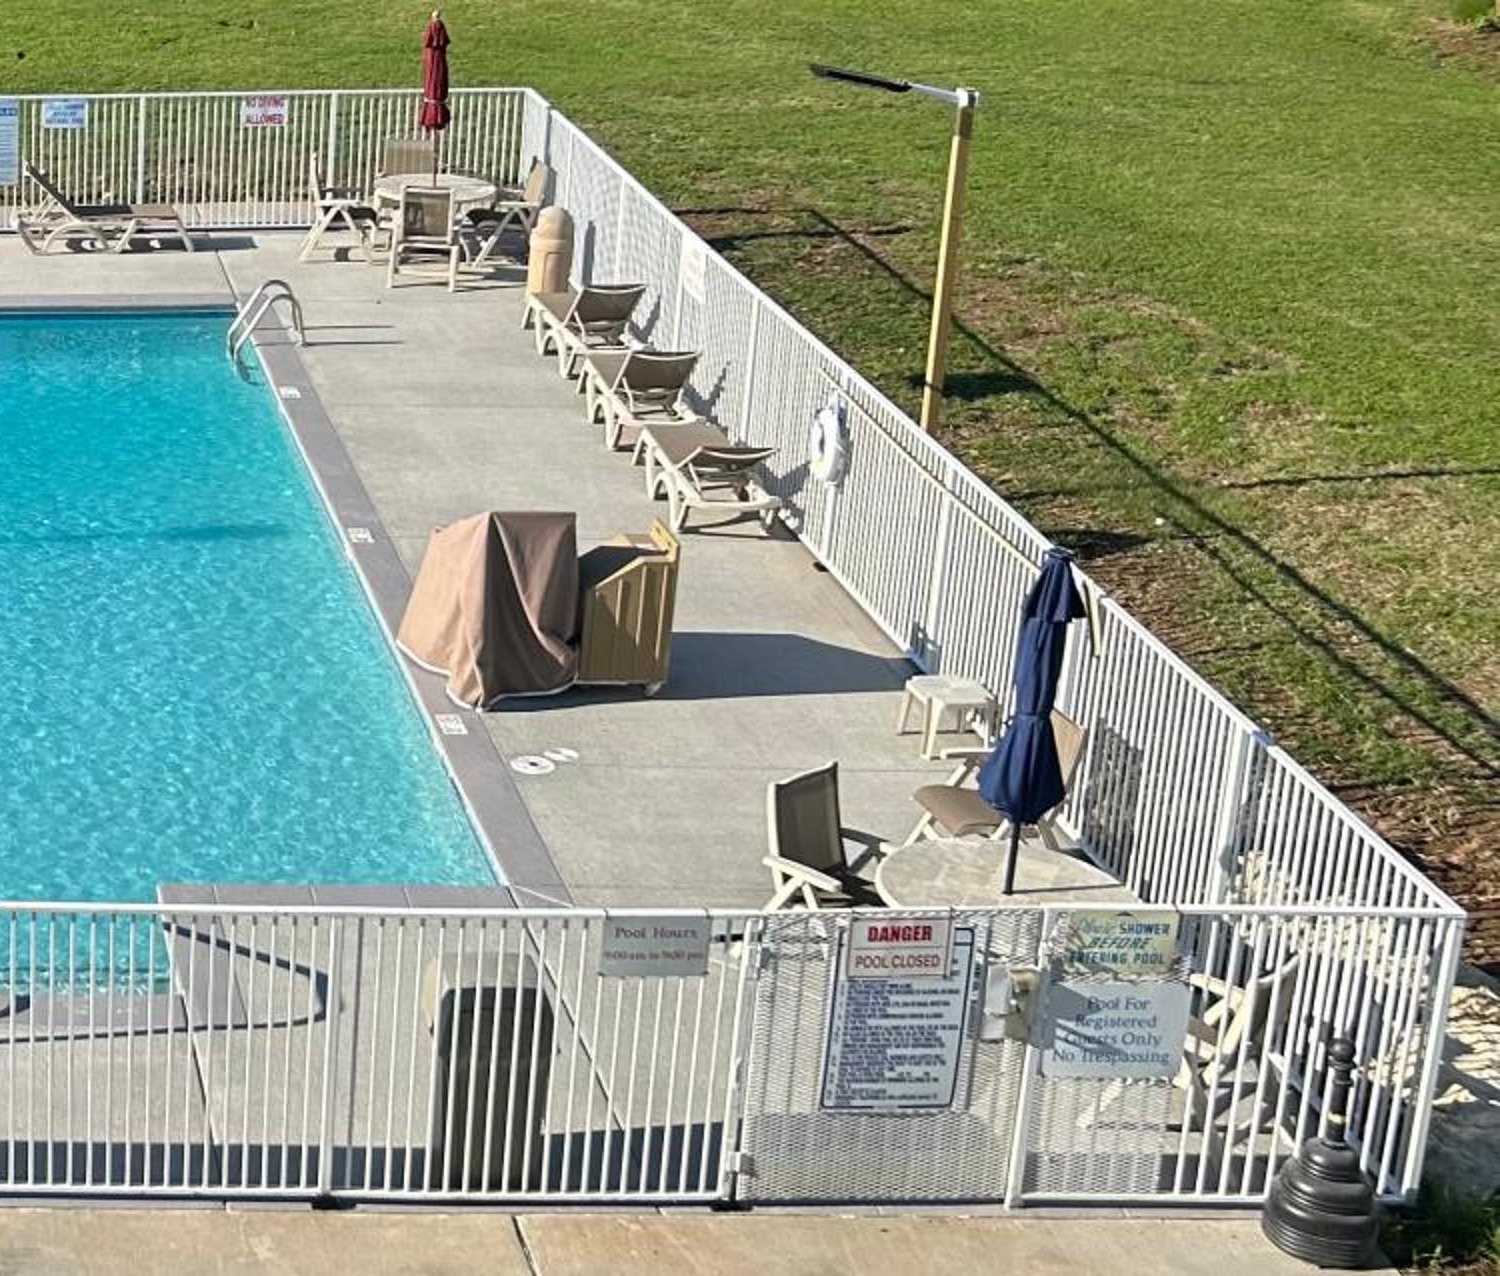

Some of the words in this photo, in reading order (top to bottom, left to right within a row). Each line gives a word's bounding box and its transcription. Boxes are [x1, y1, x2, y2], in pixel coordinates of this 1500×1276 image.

[614, 927, 646, 938] Pool
[653, 927, 698, 938] Hours
[867, 925, 933, 942] DANGER
[1119, 922, 1171, 935] SHOWER
[1088, 936, 1153, 949] BEFORE
[854, 955, 889, 969] POOL
[891, 954, 940, 968] CLOSED
[1068, 950, 1126, 963] ENTERING
[1133, 952, 1164, 965] POOL
[1087, 996, 1119, 1010] Pool
[1124, 997, 1151, 1010] For
[1075, 1013, 1157, 1030] Registered
[1065, 1033, 1117, 1044] Guests
[1121, 1032, 1162, 1047] Only
[1052, 1049, 1075, 1062] No
[1083, 1049, 1170, 1066] Trespassing
